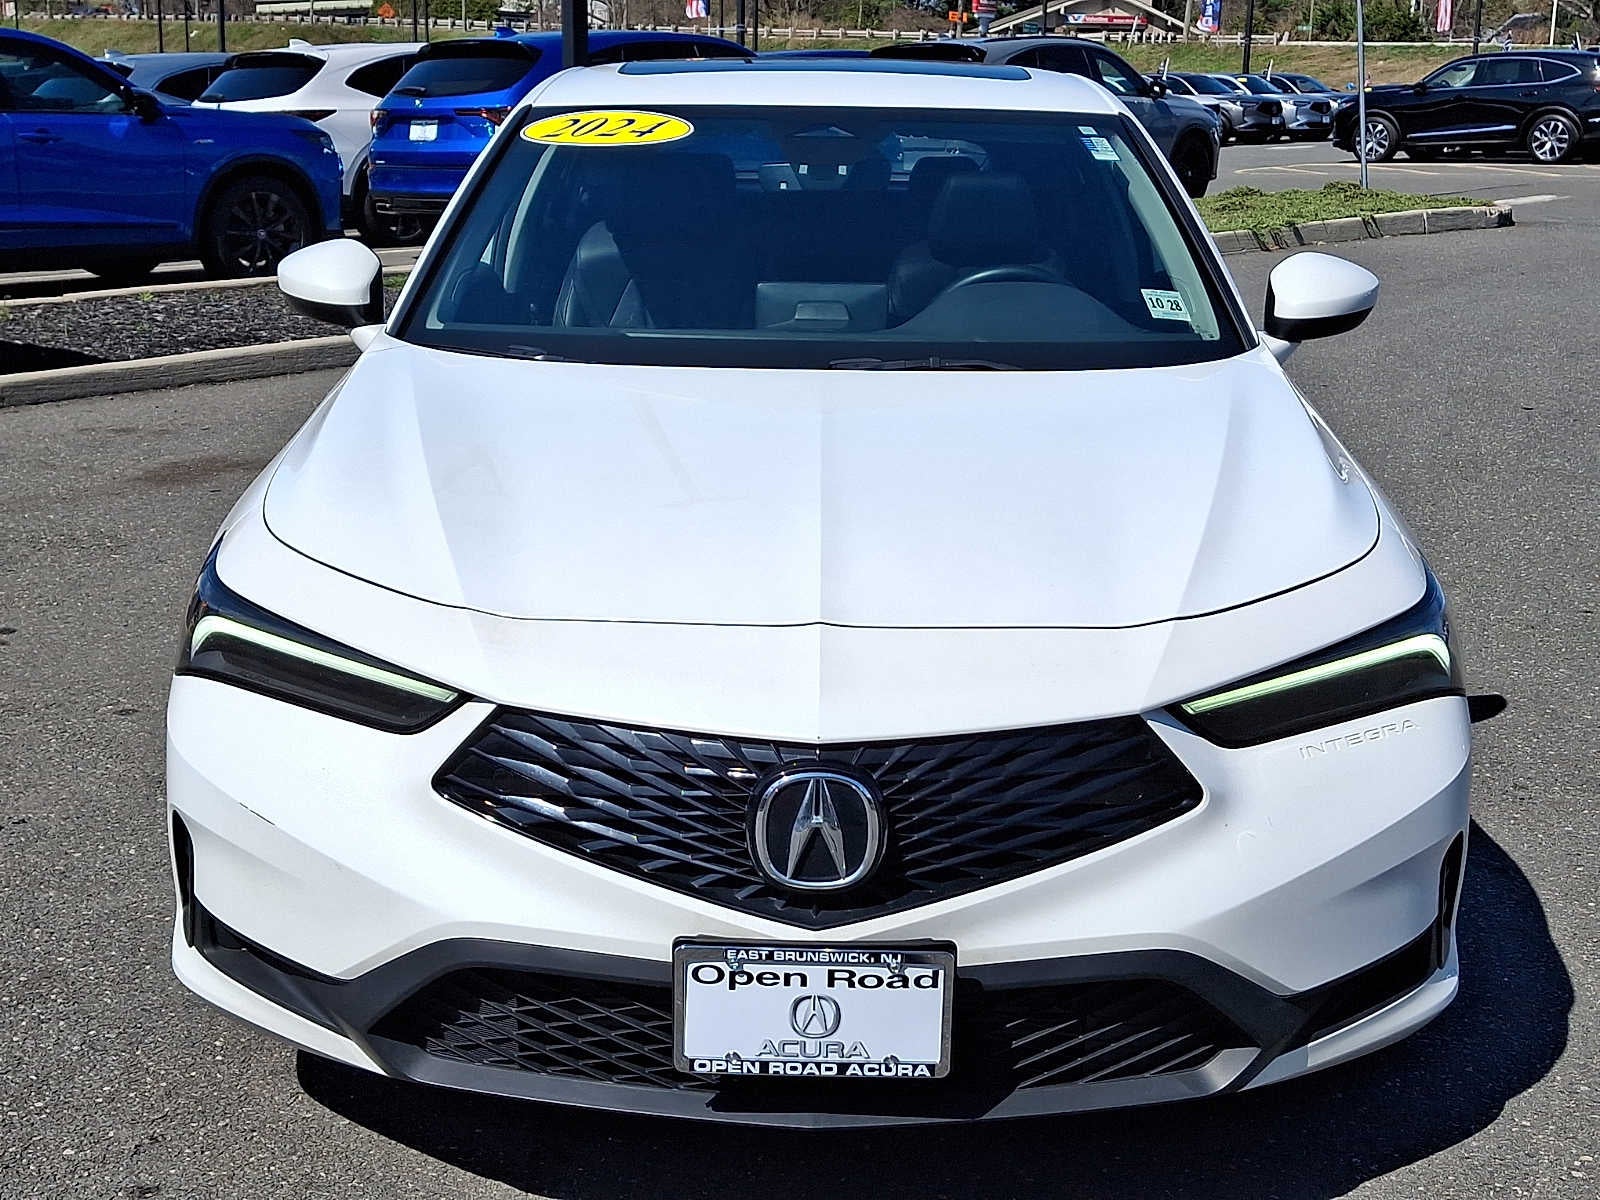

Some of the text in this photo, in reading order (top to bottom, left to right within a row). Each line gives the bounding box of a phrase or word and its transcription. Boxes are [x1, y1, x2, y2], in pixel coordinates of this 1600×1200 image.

[540, 118, 671, 138] 2024
[1148, 297, 1183, 312] 10 28
[1299, 719, 1419, 759] INTEGRA
[727, 949, 769, 961] EAST
[880, 953, 902, 964] NJ
[691, 964, 939, 991] Open Road
[755, 1039, 871, 1059] ACURA
[693, 1059, 932, 1078] OPEN ROAD ACURA
